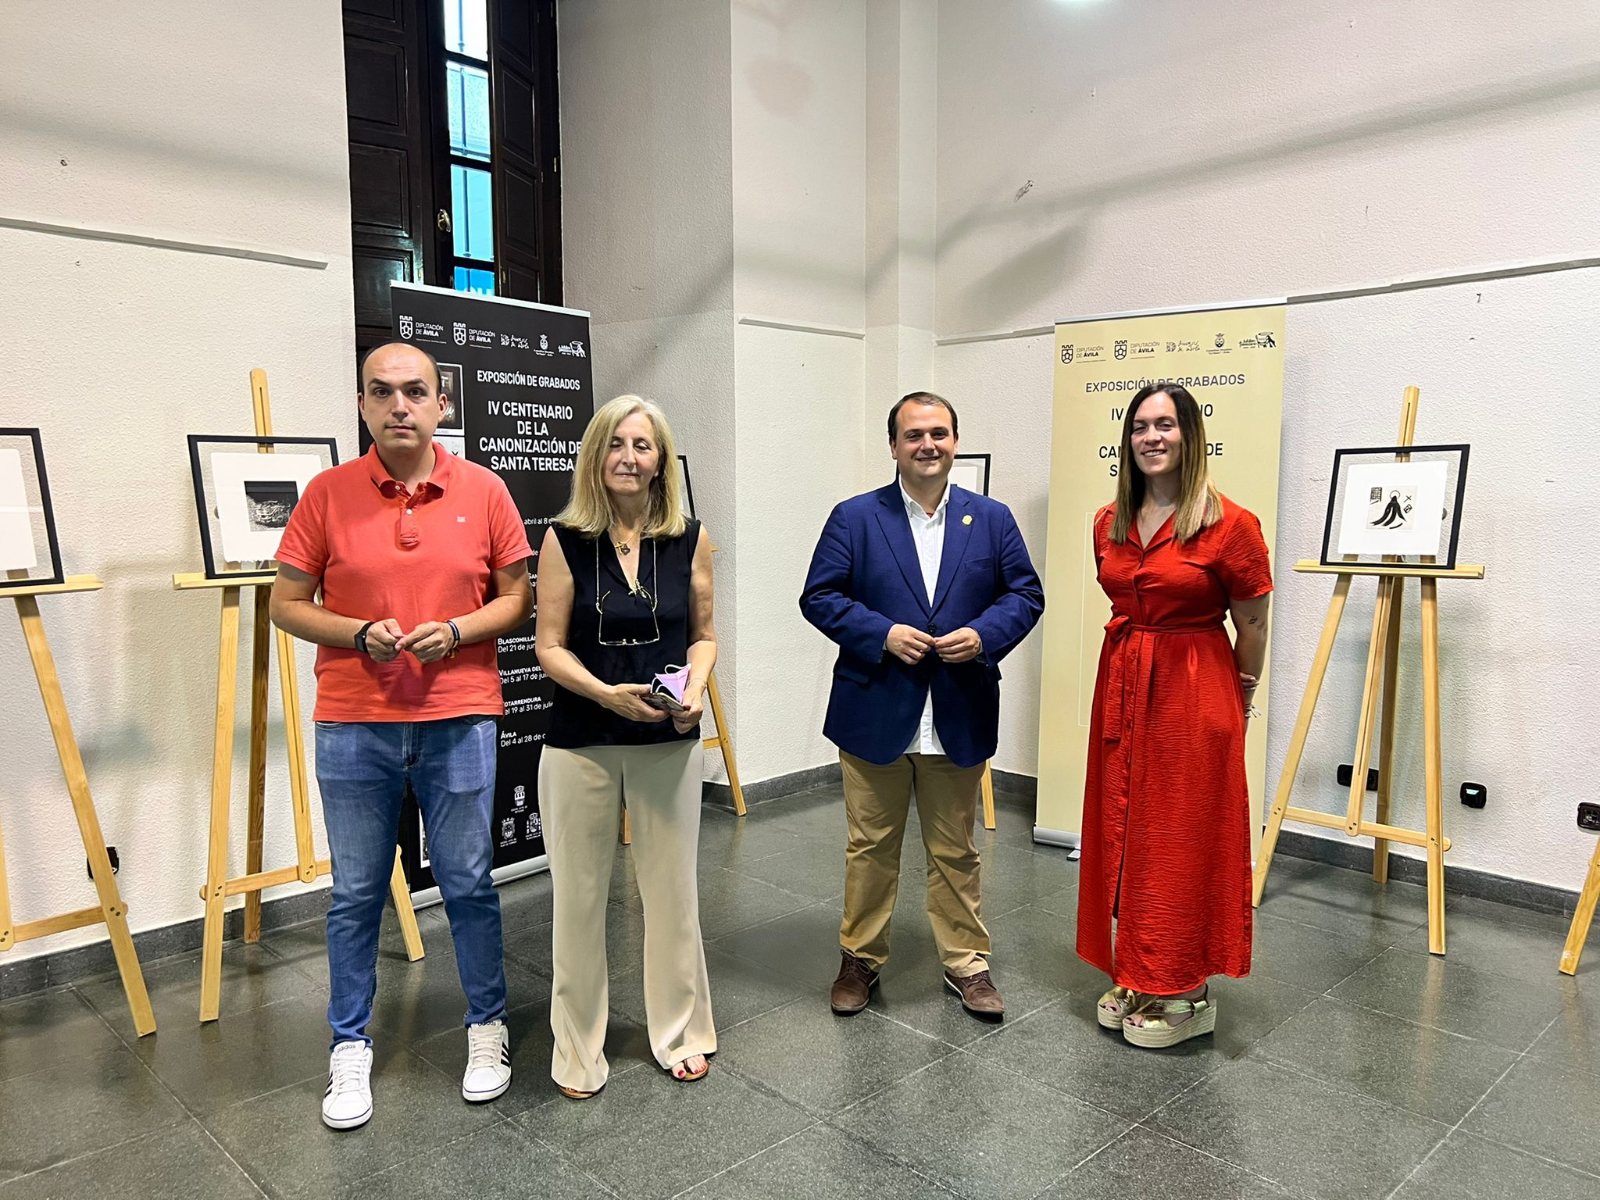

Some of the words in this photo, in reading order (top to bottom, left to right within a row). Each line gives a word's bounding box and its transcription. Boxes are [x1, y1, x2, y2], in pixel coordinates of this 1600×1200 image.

[415, 322, 444, 331] DIPUTACIÓN
[468, 329, 496, 338] DIPUTACIÓN
[476, 369, 525, 386] EXPOSICIÓN
[526, 375, 538, 387] DE
[538, 376, 581, 391] GRABADOS
[1085, 376, 1154, 393] EXPOSICIÓN
[1176, 374, 1245, 388] GRABADOS
[487, 400, 500, 415] IV
[502, 401, 573, 420] CENTENARIO
[1111, 407, 1124, 421] IV
[516, 420, 532, 435] DE
[534, 421, 549, 436] LA
[479, 436, 566, 454] CANONIZACIÓN
[568, 440, 582, 455] DE
[490, 456, 531, 471] SANTA
[531, 457, 575, 472] TERESA
[523, 517, 536, 525] abril
[497, 645, 508, 653] Del
[509, 644, 517, 652] 21
[517, 643, 526, 651] de
[510, 675, 515, 683] 5
[515, 675, 522, 683] al
[522, 673, 529, 681] 17
[503, 696, 542, 708] OTARRENDURA
[511, 706, 518, 714] 19
[518, 705, 525, 713] al
[525, 704, 533, 712] 31
[500, 739, 511, 748] Del
[517, 736, 523, 744] al
[524, 734, 532, 743] 28
[533, 733, 541, 741] de
